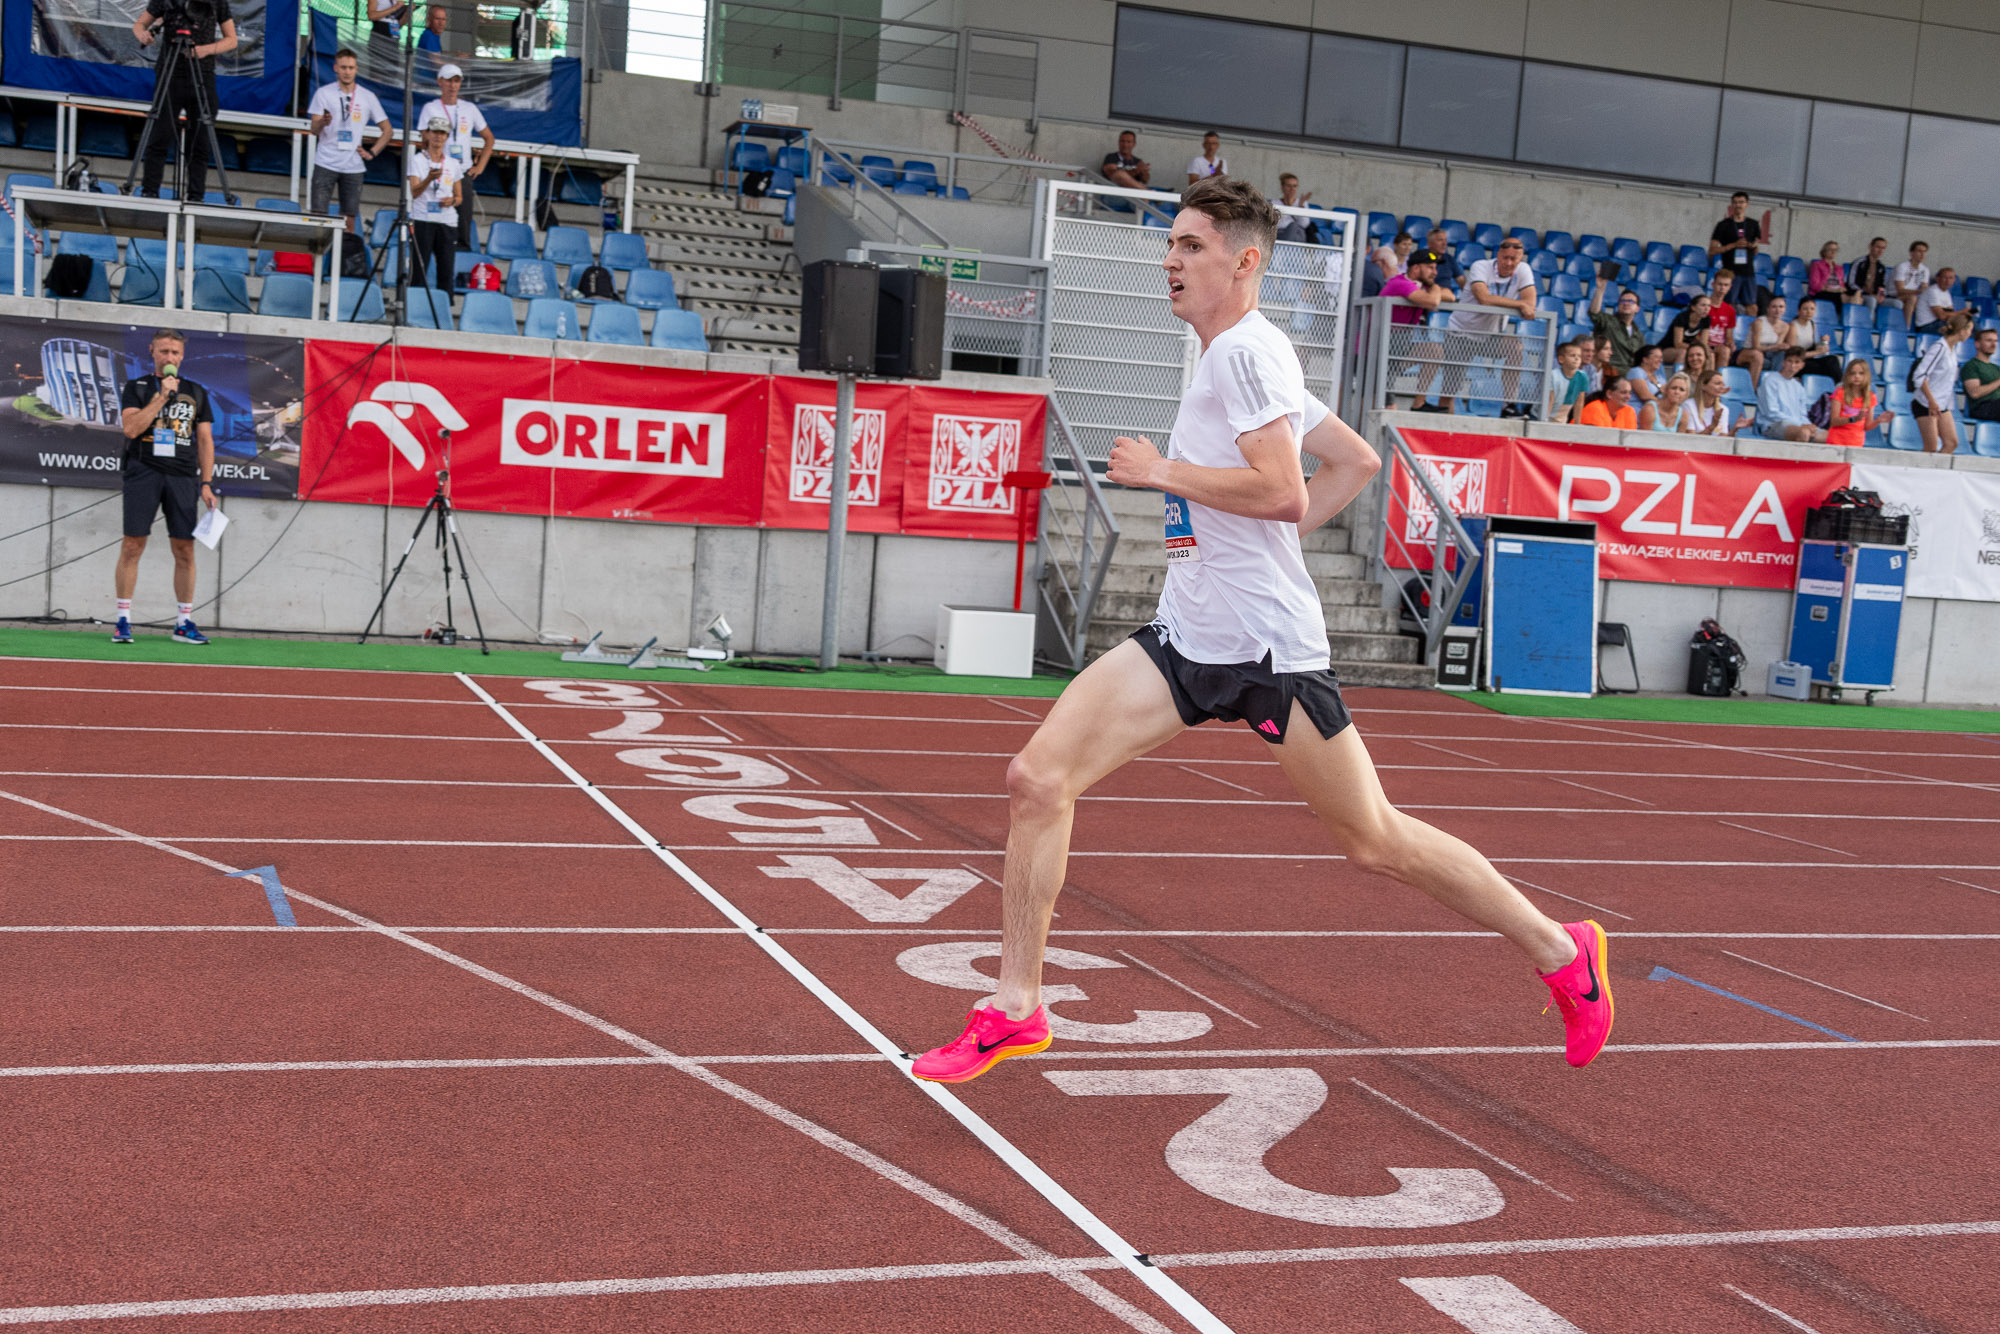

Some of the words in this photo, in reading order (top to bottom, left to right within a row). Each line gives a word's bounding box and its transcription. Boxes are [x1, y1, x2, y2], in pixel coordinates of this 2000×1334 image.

[515, 410, 711, 466] ORLEN
[933, 479, 1011, 510] PZLA
[1558, 464, 1795, 544] PZLA
[1608, 542, 1674, 559] ZWIĄZEK
[1676, 547, 1730, 562] LEKKIEJ
[1732, 551, 1795, 566] ATLETYKI
[523, 679, 660, 709] 8
[588, 710, 737, 743] 7
[681, 793, 881, 847] 5
[756, 853, 984, 924] 4
[895, 941, 1213, 1045] 3
[1042, 1066, 1507, 1229] 2
